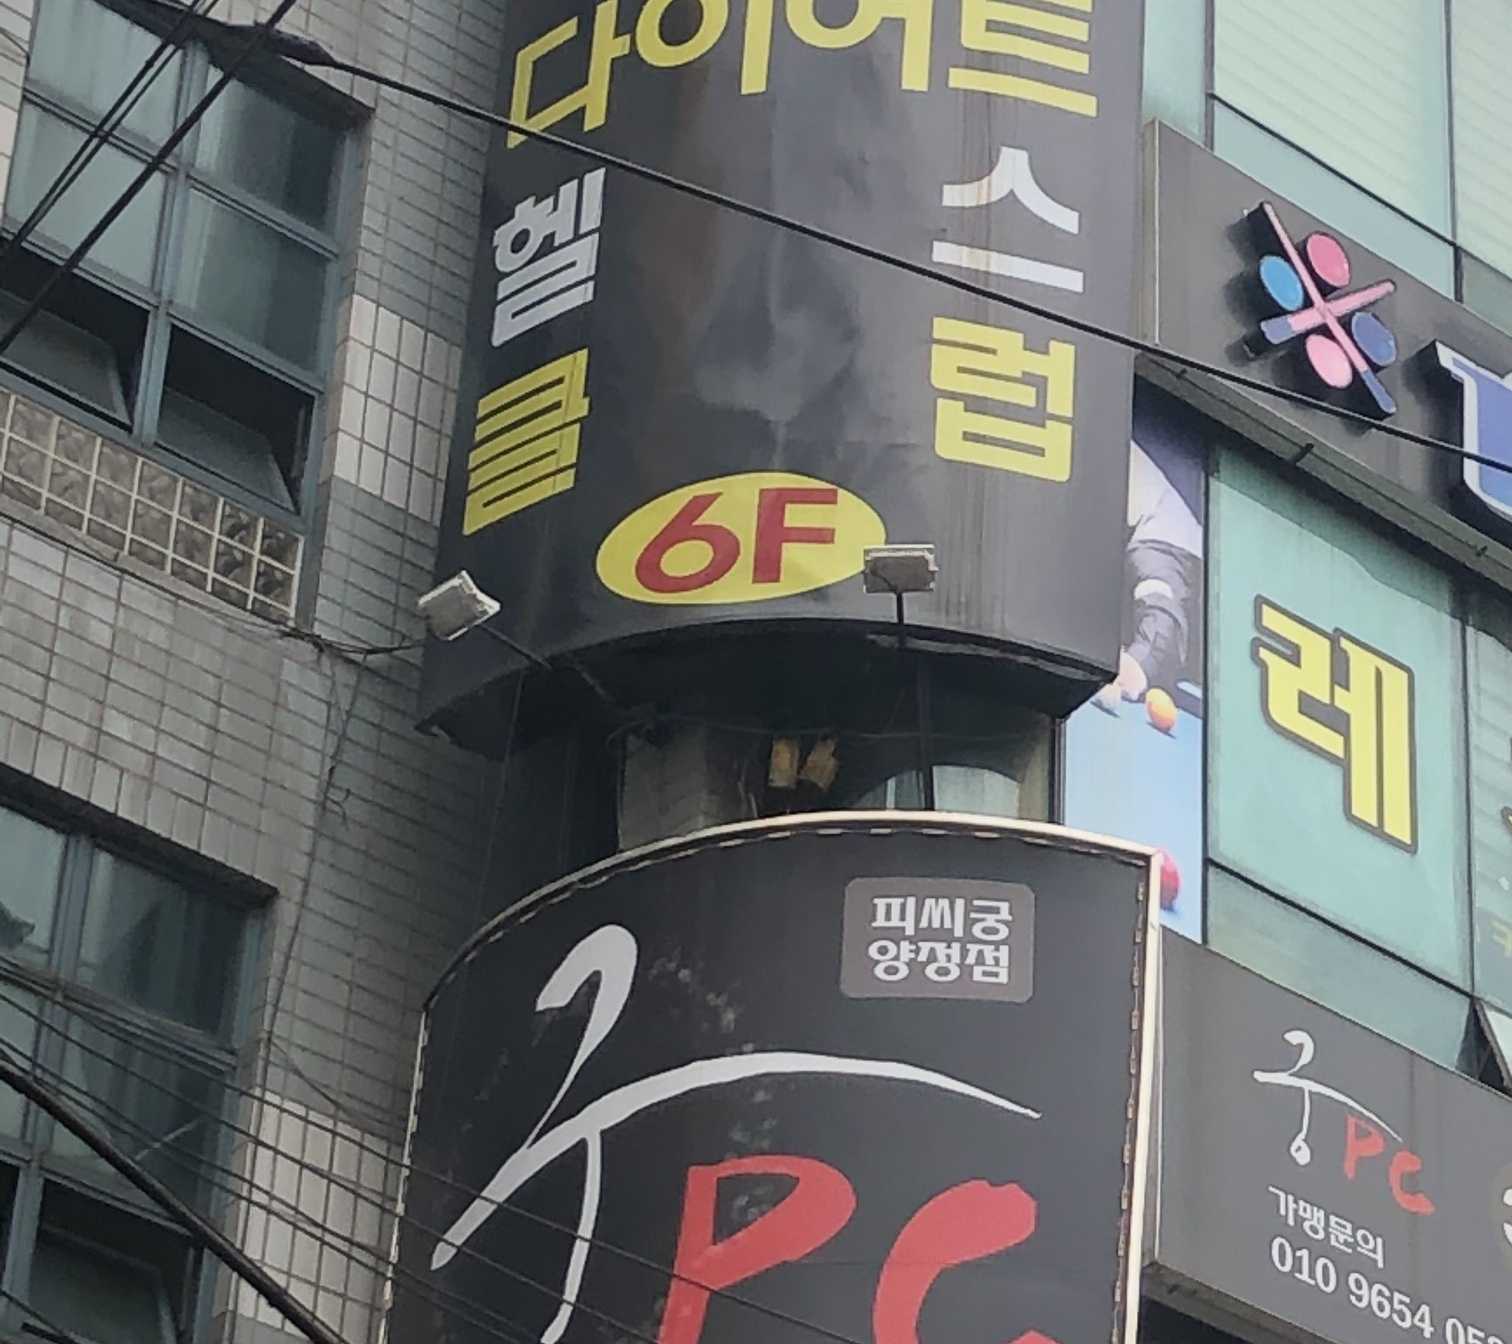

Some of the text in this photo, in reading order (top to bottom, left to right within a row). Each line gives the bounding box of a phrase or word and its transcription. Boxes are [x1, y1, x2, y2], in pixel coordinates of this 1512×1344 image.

[634, 485, 838, 594] 6F
[867, 939, 1010, 985] 양정점
[871, 896, 1013, 942] 피씨궁
[1343, 1113, 1436, 1216] PC
[1267, 1184, 1386, 1269] 가맹문의
[1270, 1235, 1338, 1295] 010
[1347, 1271, 1436, 1341] 9654
